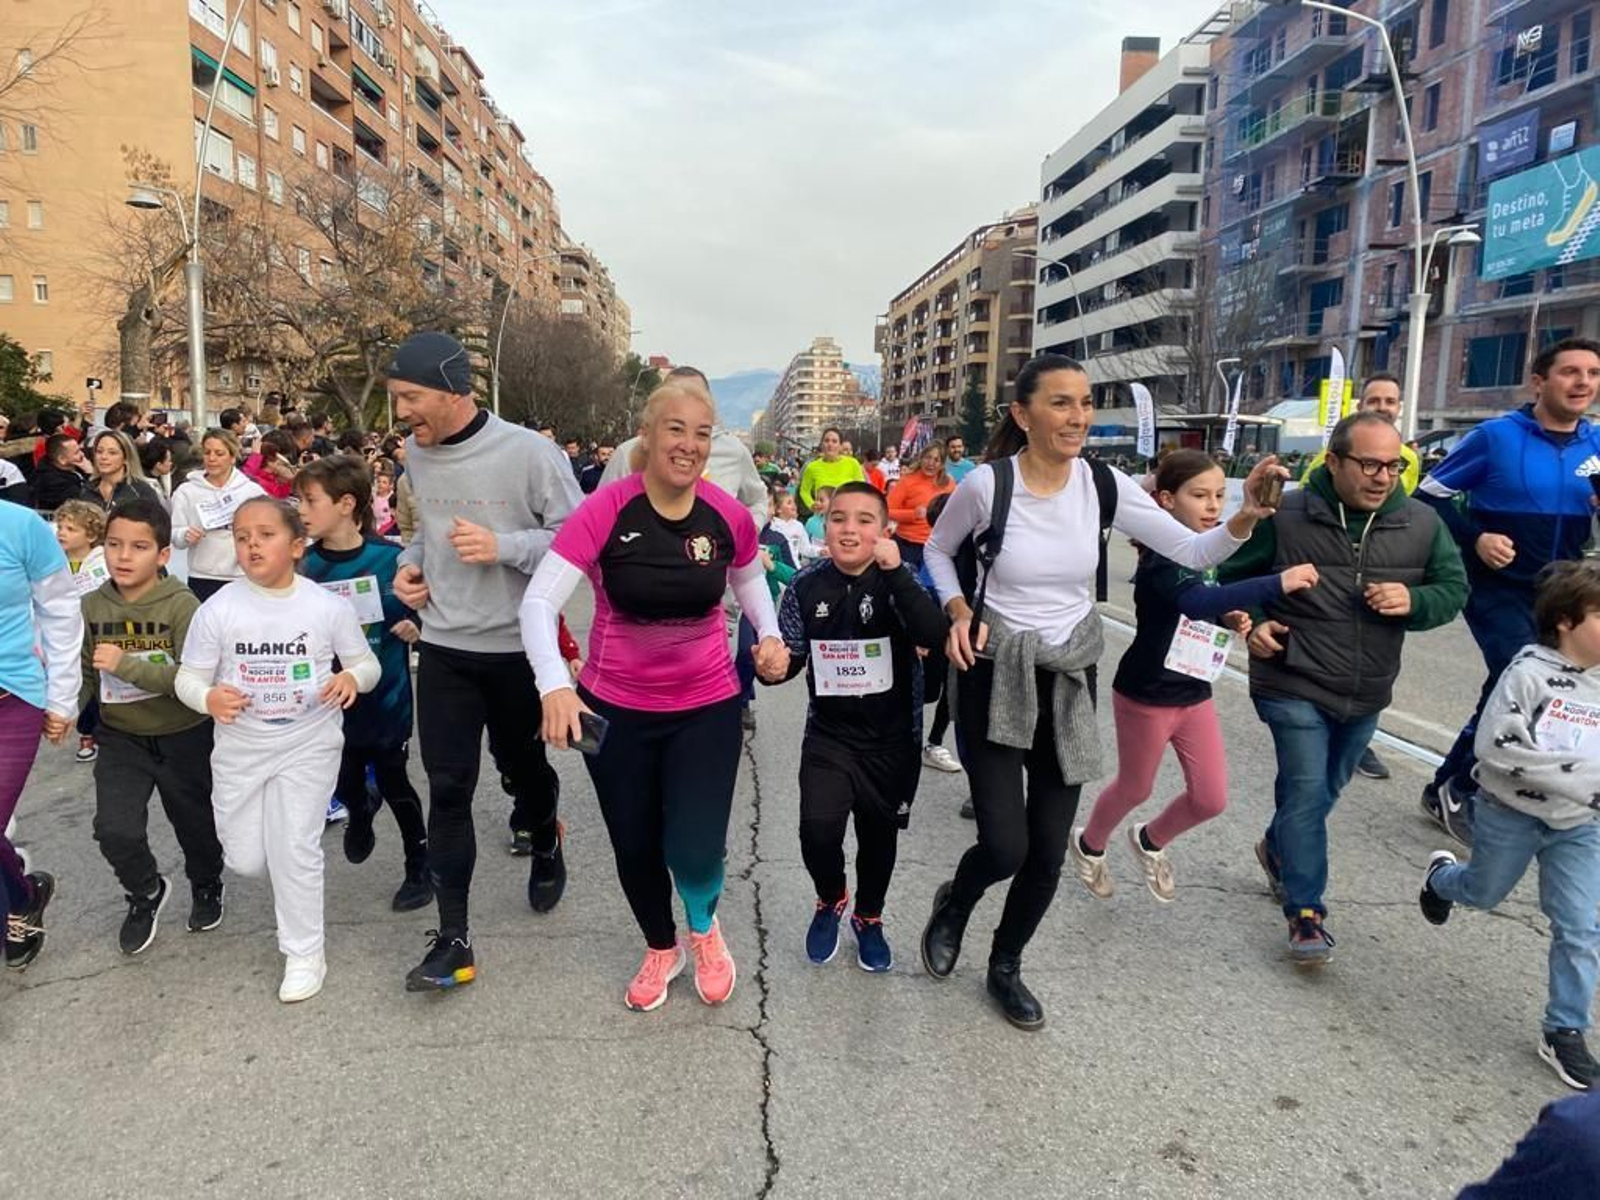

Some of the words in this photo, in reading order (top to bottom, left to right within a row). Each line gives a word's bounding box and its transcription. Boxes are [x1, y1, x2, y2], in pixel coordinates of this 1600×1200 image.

[1493, 191, 1549, 219] Destino,
[1493, 224, 1507, 238] tu
[1510, 213, 1545, 234] meta
[235, 642, 307, 656] BLANCA
[836, 666, 866, 676] 1823
[263, 693, 287, 703] 856
[1548, 710, 1568, 720] SAN
